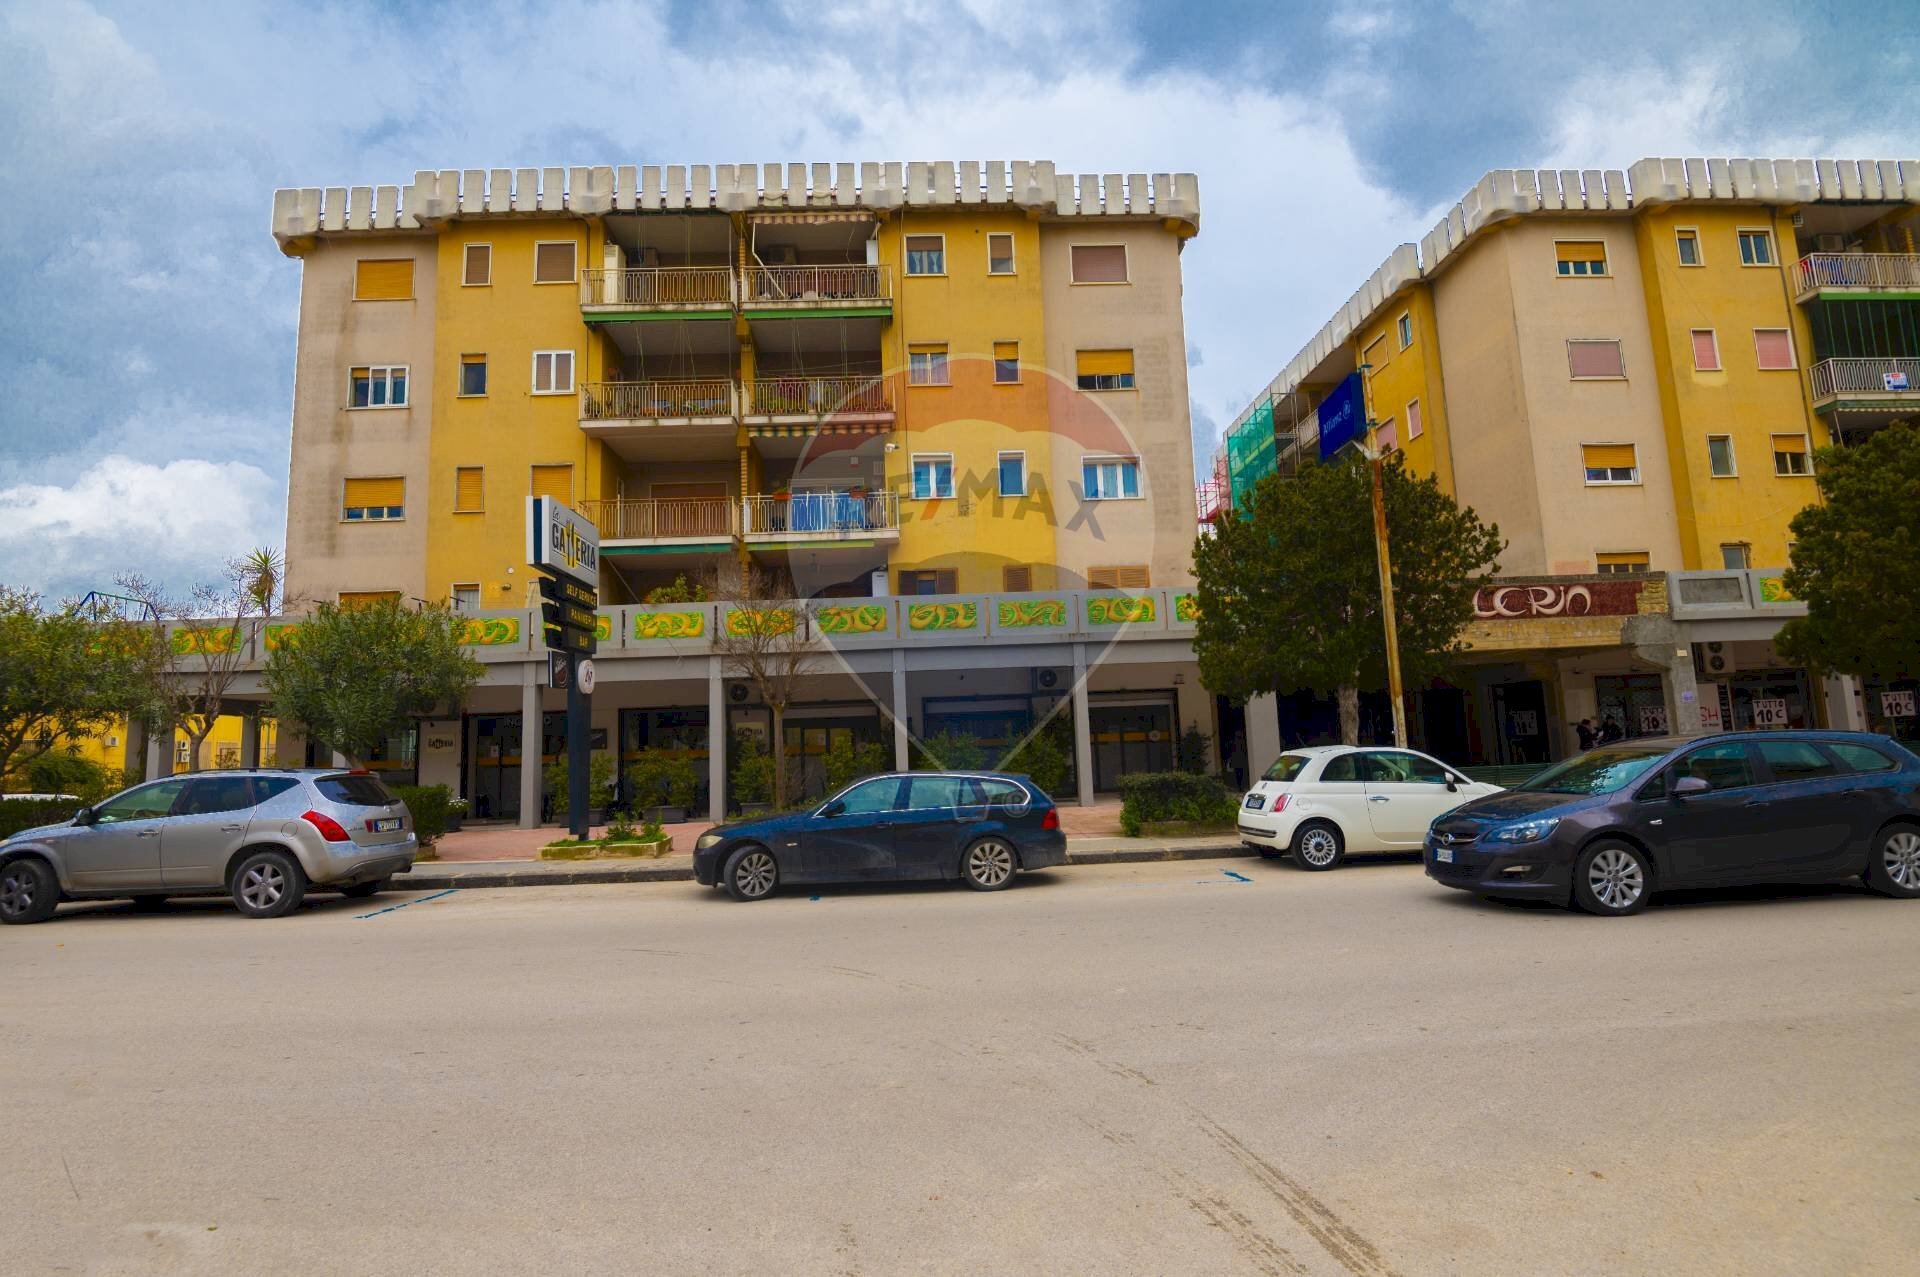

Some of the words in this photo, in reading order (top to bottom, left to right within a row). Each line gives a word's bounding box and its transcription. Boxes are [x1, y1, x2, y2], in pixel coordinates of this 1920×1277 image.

[566, 583, 578, 597] SELF
[579, 589, 597, 606] SERVICE
[570, 609, 596, 627] PANINERIA
[579, 634, 589, 648] BAR
[1753, 699, 1784, 708] TUTTO
[1885, 702, 1903, 715] 10
[1757, 709, 1773, 722] 10
